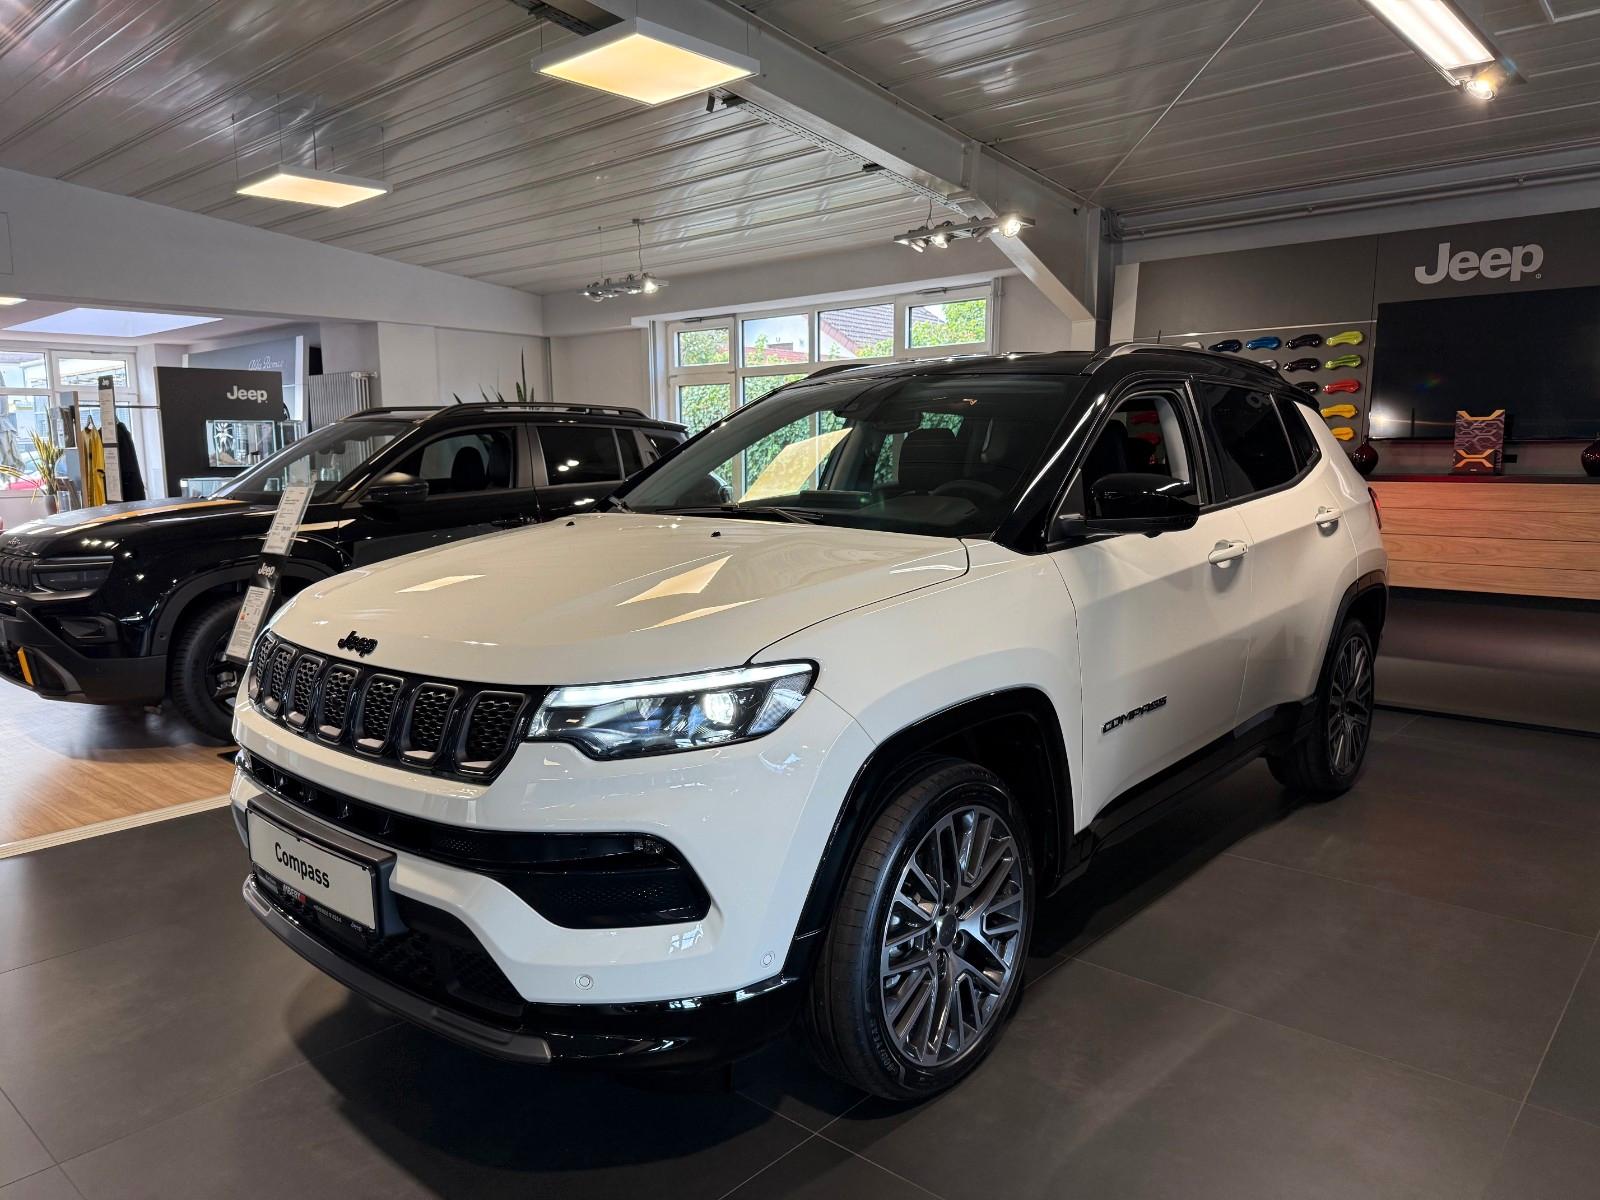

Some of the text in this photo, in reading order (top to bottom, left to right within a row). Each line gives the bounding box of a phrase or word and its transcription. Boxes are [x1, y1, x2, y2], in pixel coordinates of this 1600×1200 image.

[1414, 242, 1544, 285] Jeep
[226, 385, 268, 403] Jeep
[257, 562, 276, 578] Jeep
[337, 630, 378, 657] Jeep
[1102, 695, 1168, 734] COMPASS
[274, 842, 330, 889] Compass
